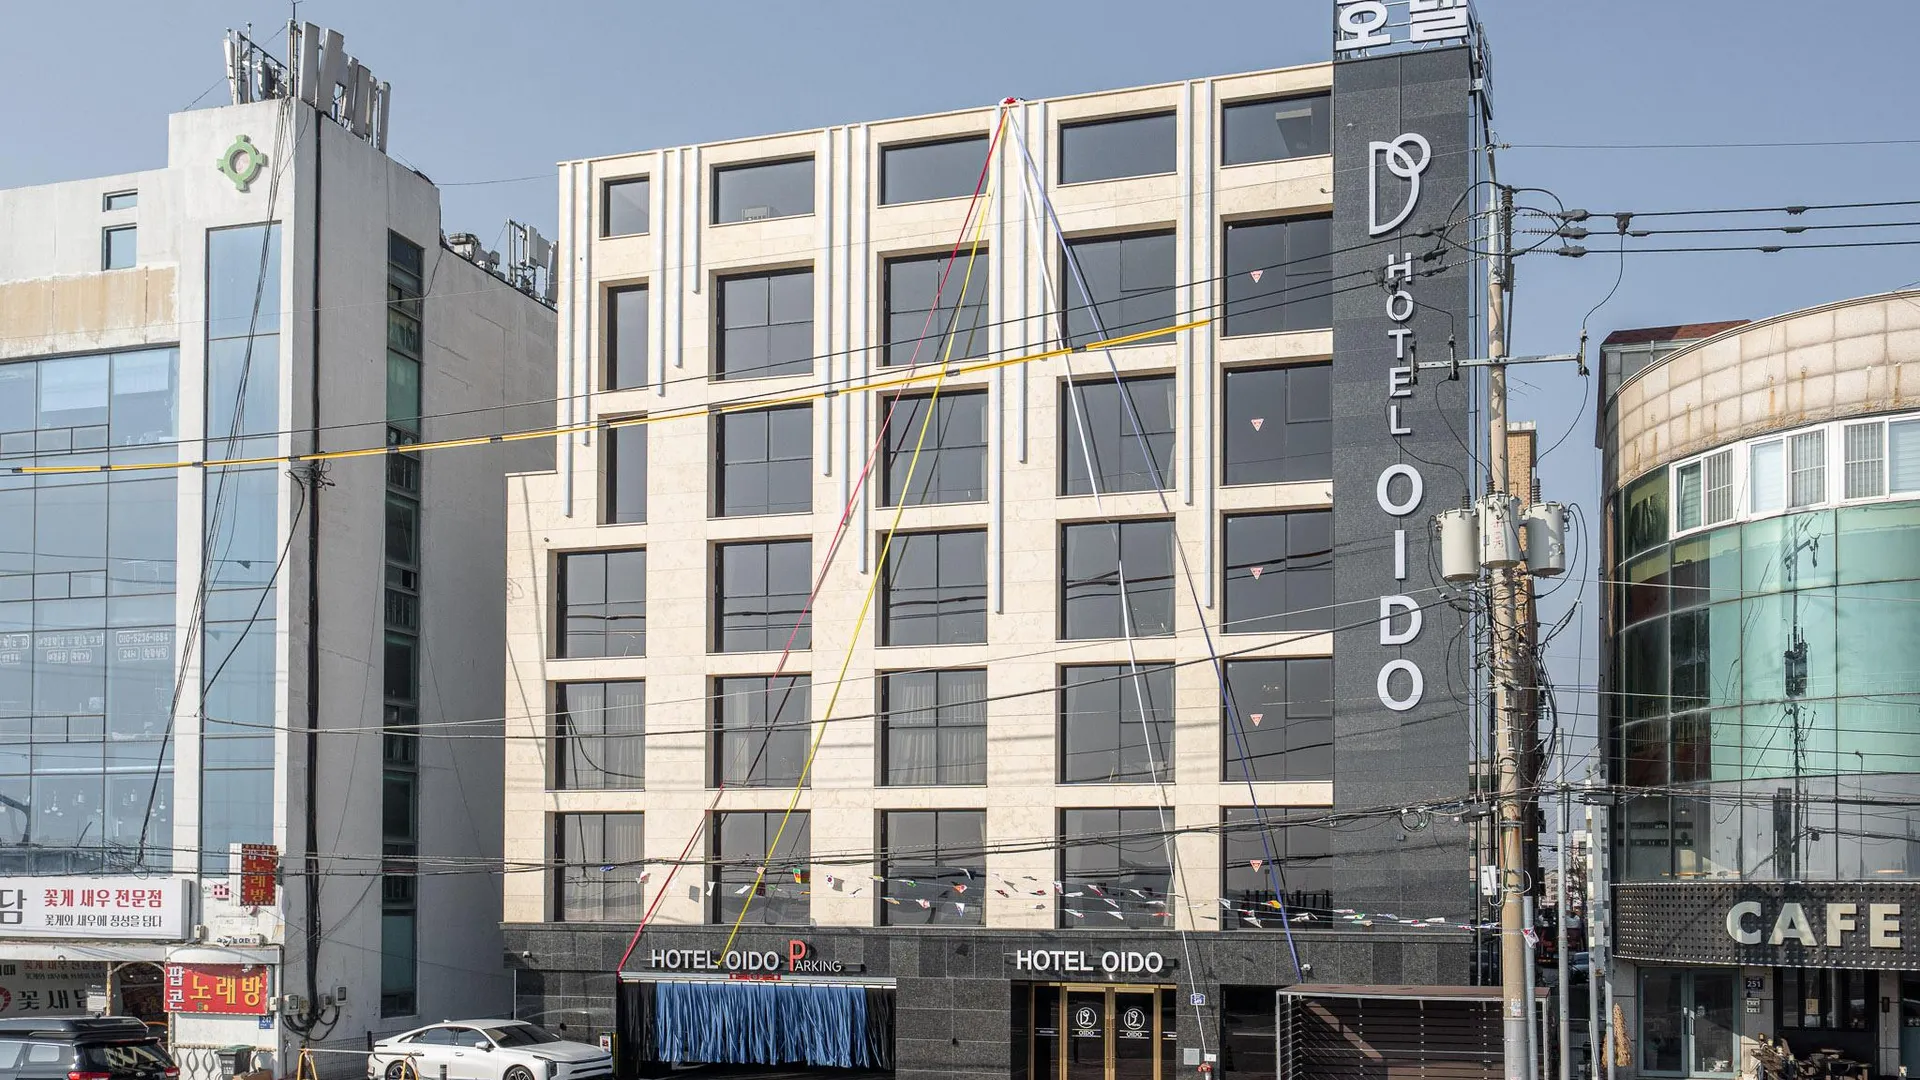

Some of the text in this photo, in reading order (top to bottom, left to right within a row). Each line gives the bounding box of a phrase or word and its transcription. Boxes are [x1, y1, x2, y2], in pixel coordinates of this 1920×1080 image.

[1376, 252, 1424, 711] HOTEL OIDO
[44, 889, 162, 908] 꽃게 새우 전문점
[45, 914, 162, 927] 꽃게와 새우에 정성을 담다
[1726, 901, 1901, 948] CAFE
[651, 949, 718, 970] HOTEL
[725, 950, 780, 971] OIDO
[1016, 949, 1164, 974] HOTEL OIDO
[167, 965, 185, 1010] 팝콘
[189, 975, 264, 1007] 노래방
[1747, 980, 1761, 988] 251
